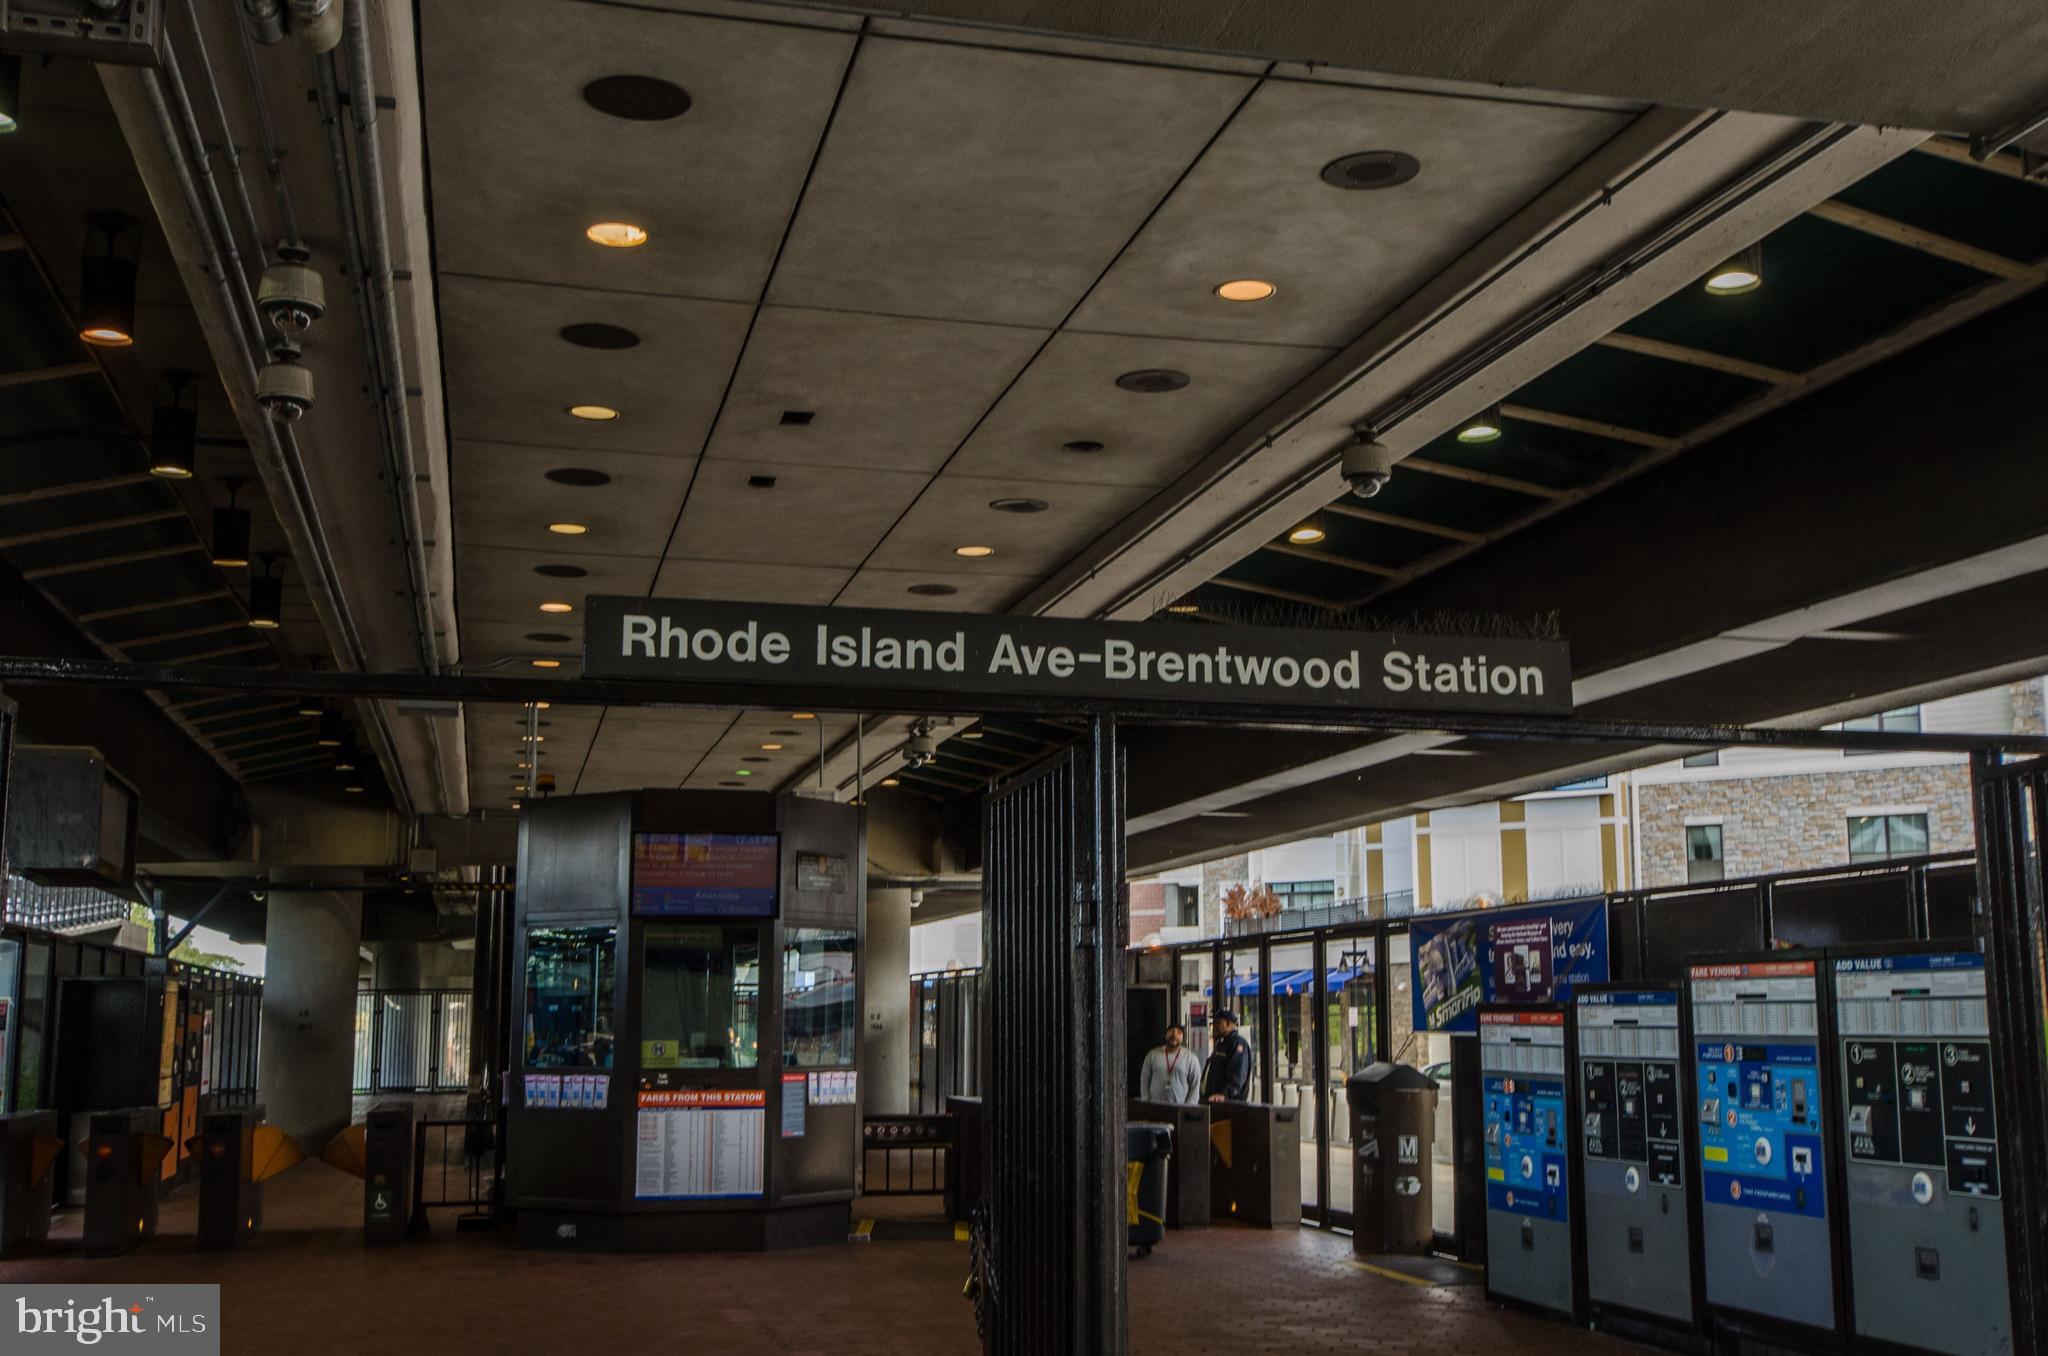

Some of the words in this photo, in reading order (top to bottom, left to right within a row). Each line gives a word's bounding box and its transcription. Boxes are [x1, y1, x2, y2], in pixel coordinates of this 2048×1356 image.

[621, 614, 791, 665] Rhode
[816, 623, 965, 673] Island
[1382, 650, 1544, 697] Station
[1552, 920, 1574, 938] very
[1552, 940, 1567, 959] nd
[1691, 966, 1709, 977] FARE
[1710, 965, 1741, 977] VENDING
[1836, 960, 1853, 970] ADD
[1854, 958, 1882, 970] VALUE
[1435, 984, 1481, 1028] SmarTrip
[1577, 993, 1588, 1004] ADD
[1589, 993, 1608, 1004] VALUE
[640, 1092, 671, 1103] FARES
[672, 1092, 699, 1103] FROM
[700, 1092, 722, 1102] THIS
[723, 1092, 763, 1102] STATION
[1398, 1136, 1418, 1157] M
[1398, 1156, 1418, 1165] metro
